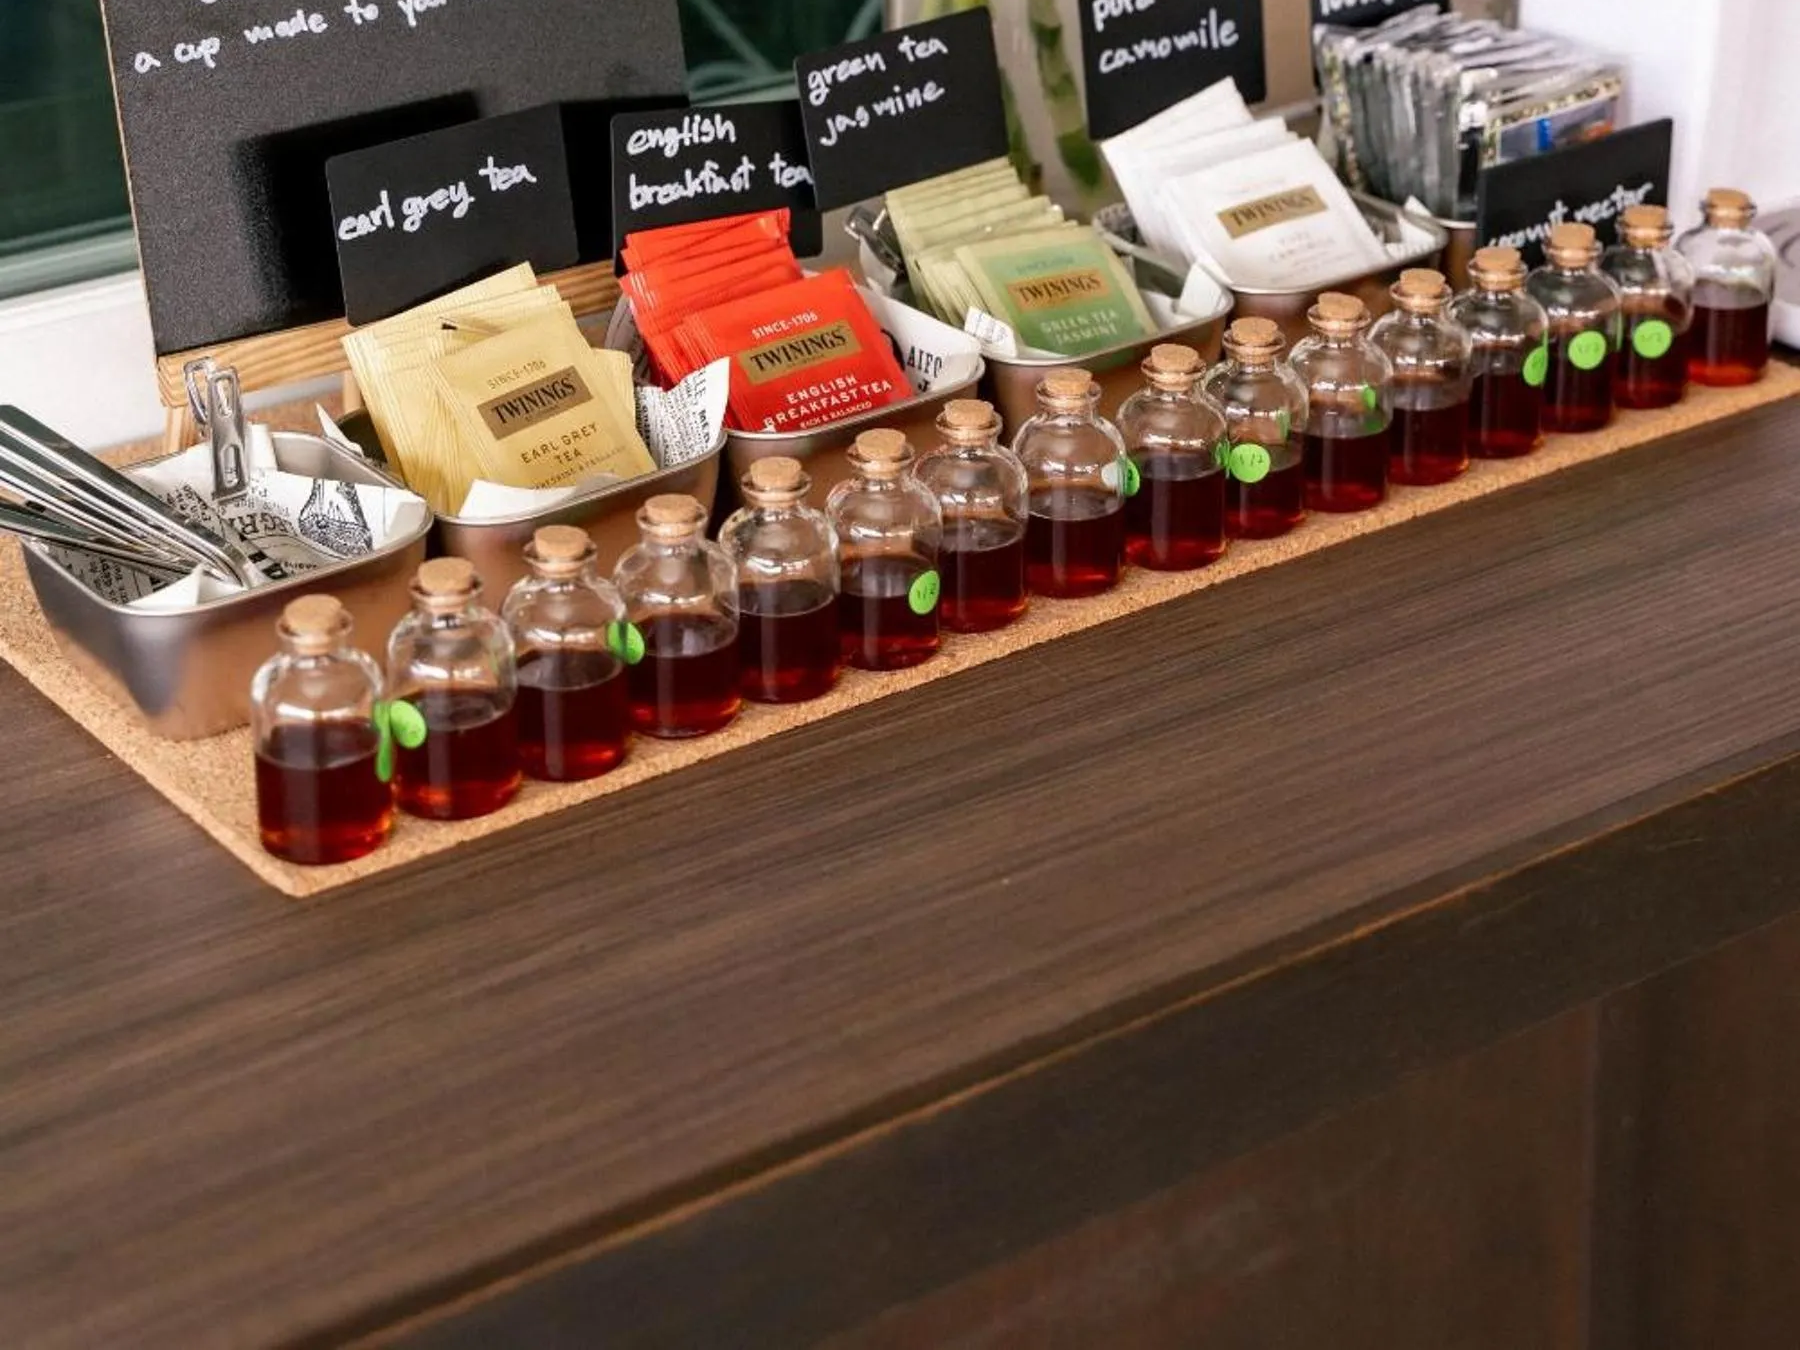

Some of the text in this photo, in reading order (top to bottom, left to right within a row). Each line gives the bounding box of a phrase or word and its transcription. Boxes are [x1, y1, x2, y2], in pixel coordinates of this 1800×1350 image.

[133, 51, 162, 75] a
[173, 36, 221, 69] cup
[243, 8, 329, 45] made
[1096, 7, 1239, 73] camomile
[807, 35, 948, 109] green tea
[626, 113, 737, 158] english
[337, 155, 538, 241] earl grey tea
[629, 152, 814, 211] breakfast tea
[1016, 274, 1102, 302] TWININGS
[750, 328, 846, 371] TWININGS
[492, 377, 577, 424] TWININGS
[763, 379, 892, 429] BREAKFAST TEA
[786, 375, 857, 404] ENGLISH
[521, 422, 598, 464] EARL GREY
[554, 449, 582, 465] TEA
